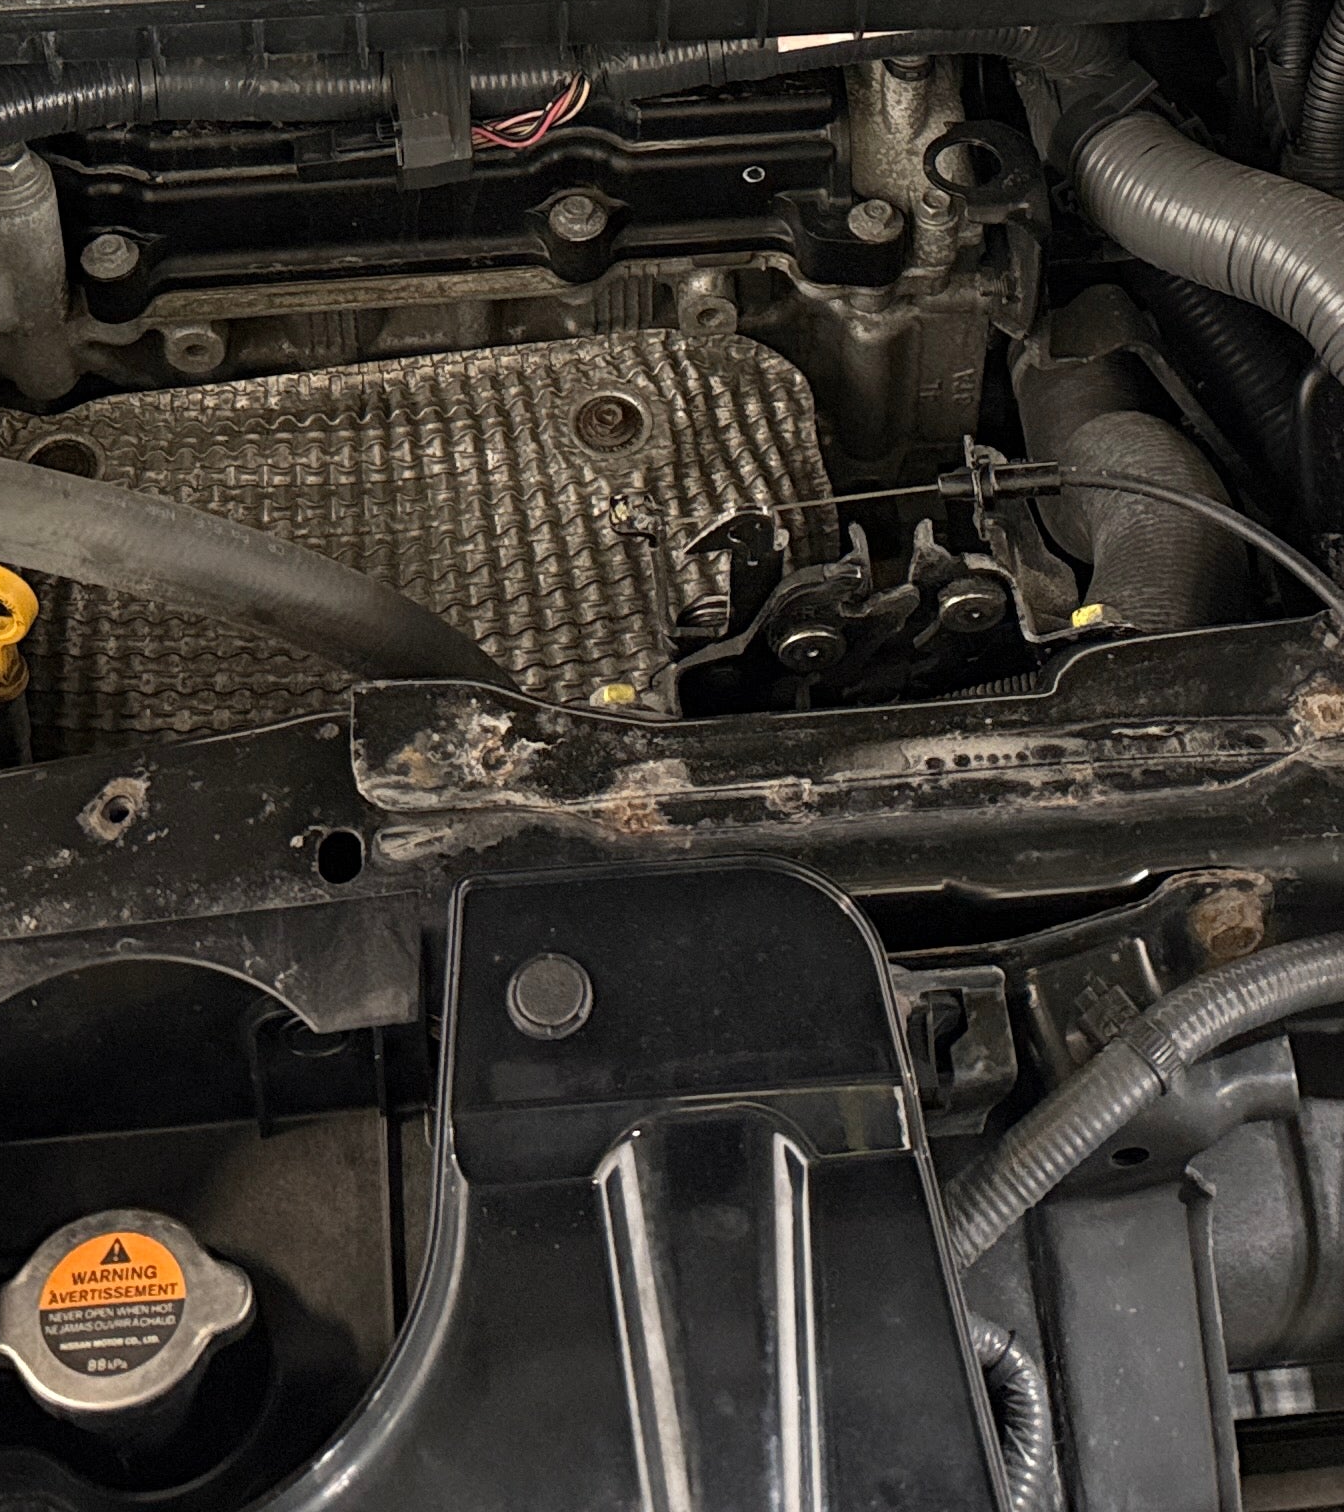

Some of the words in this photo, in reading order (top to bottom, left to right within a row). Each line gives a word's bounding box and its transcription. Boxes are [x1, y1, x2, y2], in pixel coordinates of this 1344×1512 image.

[71, 1265, 157, 1285] WARNING
[48, 1282, 178, 1305] AVERTISSEMENT
[85, 1307, 115, 1320] OPEN
